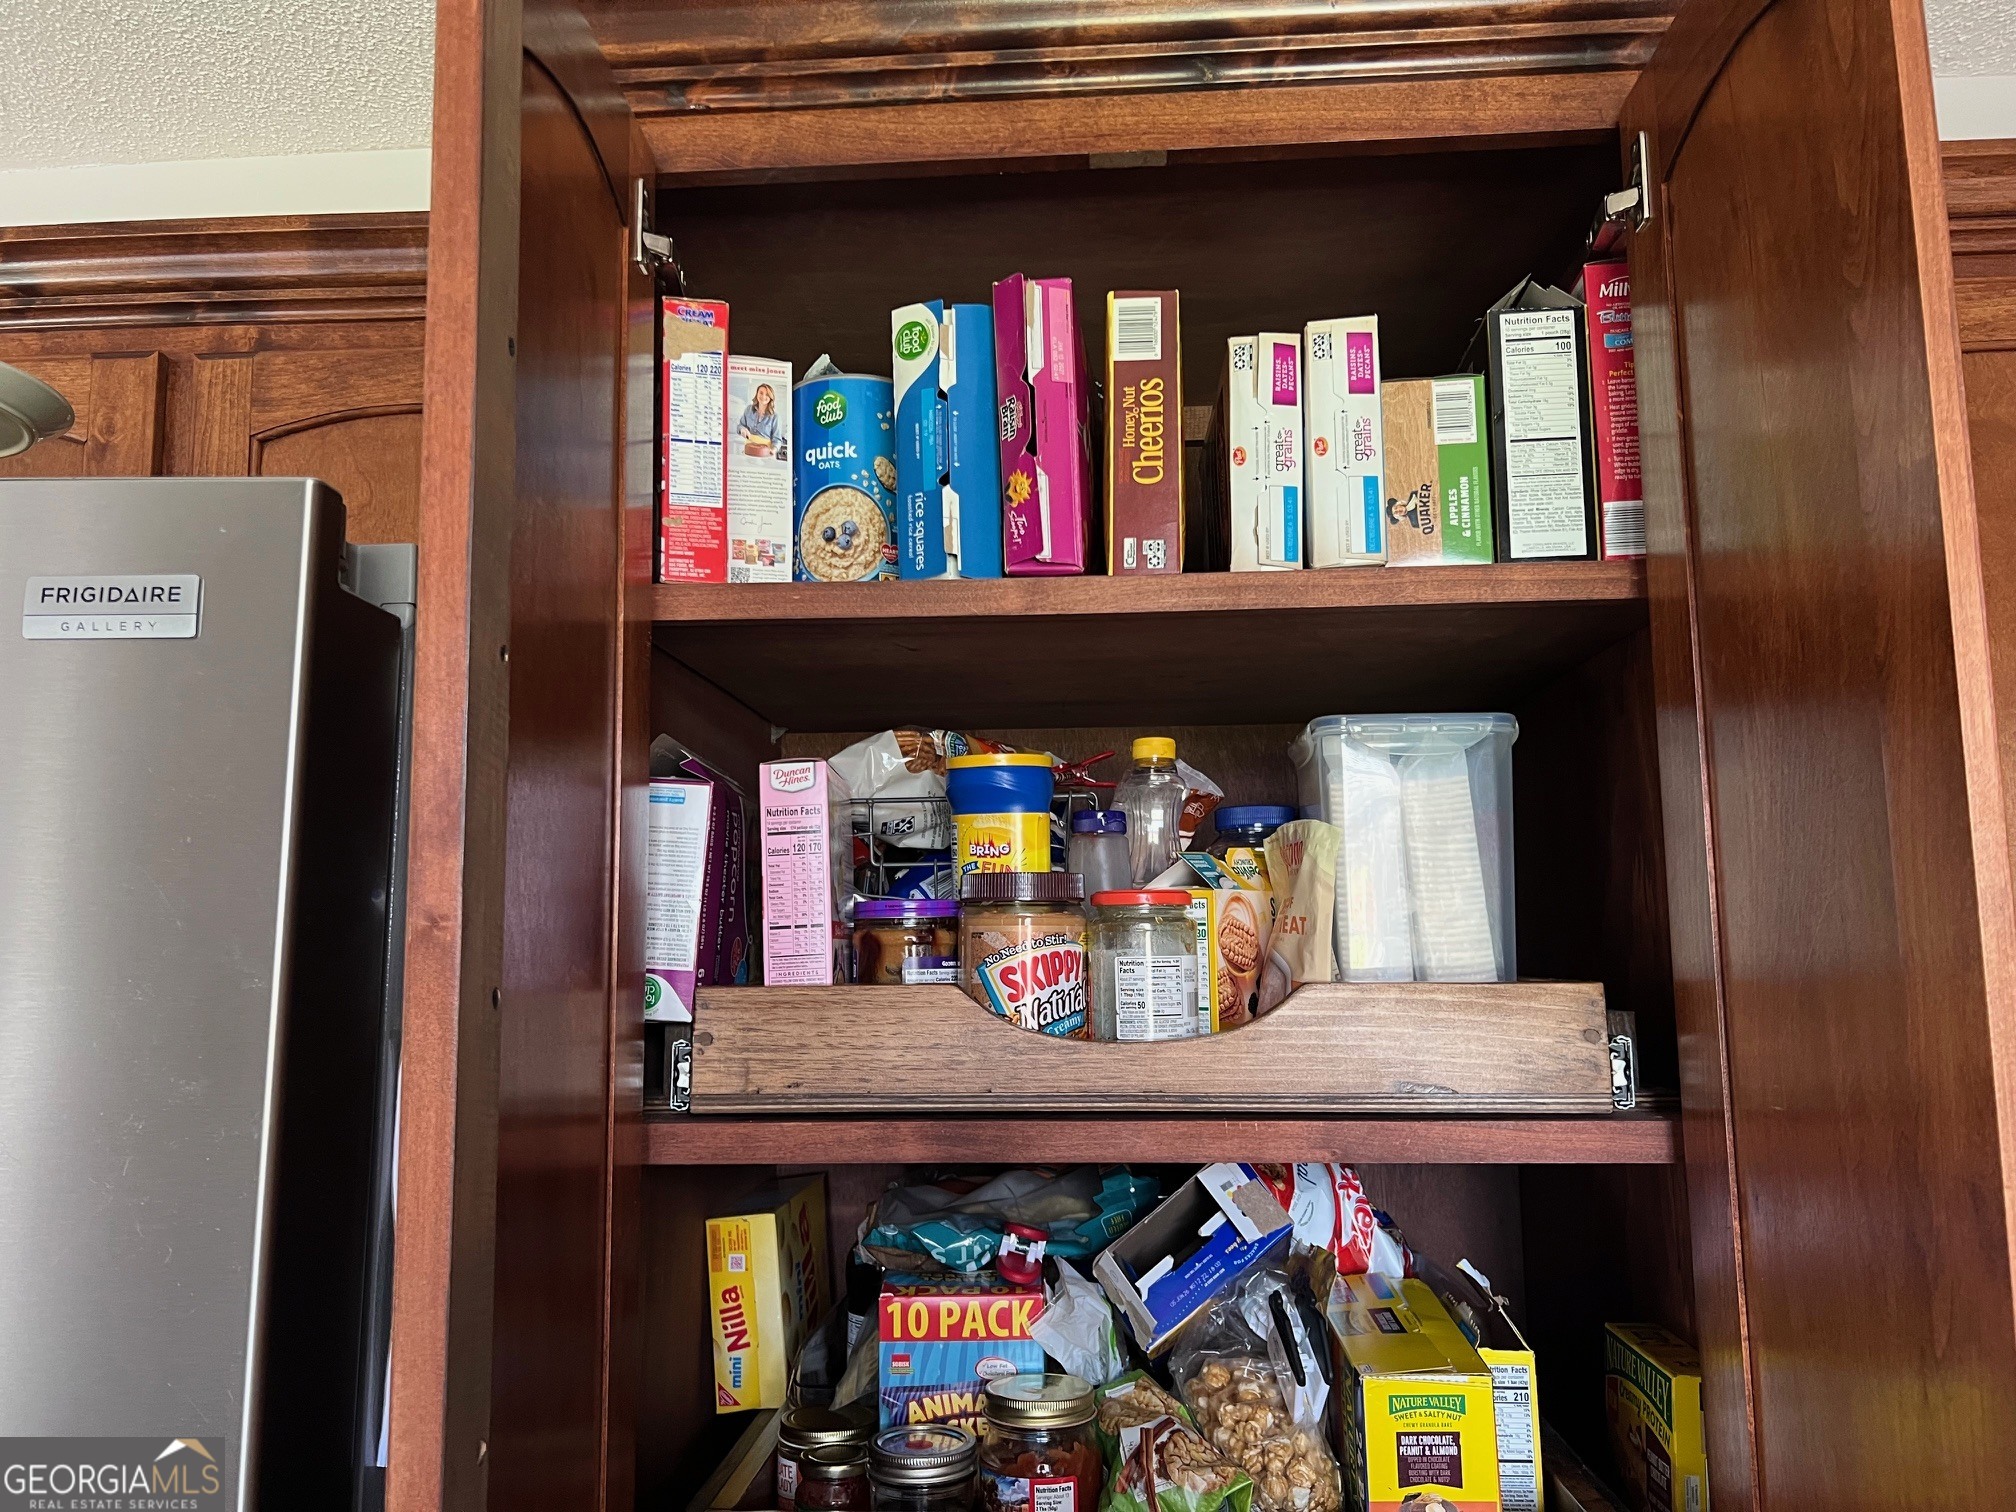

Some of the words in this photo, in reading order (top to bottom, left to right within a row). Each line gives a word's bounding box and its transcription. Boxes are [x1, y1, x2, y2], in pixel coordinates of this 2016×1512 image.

[677, 307, 715, 319] CREAM
[1505, 317, 1543, 326] Nutrition
[1546, 315, 1570, 323] Facts
[900, 329, 911, 354] club
[911, 325, 922, 353] food
[1506, 346, 1534, 354] Calories
[1556, 341, 1572, 351] 100
[671, 363, 692, 372] Calories
[697, 364, 708, 373] 120
[710, 365, 722, 374] 220
[816, 396, 841, 417] food
[1123, 386, 1136, 408] Nut
[820, 408, 843, 425] club
[1000, 405, 1010, 440] Bran
[1007, 395, 1017, 440] Raisin
[1123, 410, 1139, 448] Honey
[1132, 378, 1164, 485] Cheerios
[1362, 418, 1376, 462] grains
[805, 441, 858, 466] quick
[1275, 438, 1288, 472] great
[1283, 429, 1297, 471] grains
[1355, 428, 1368, 462] great
[818, 461, 841, 470] OATS
[915, 491, 926, 518] rice
[1422, 483, 1433, 536] QUAKER
[1449, 488, 1458, 526] APPLES
[1460, 476, 1471, 528] CINNAMON
[1007, 511, 1022, 546] Scoops!
[1016, 514, 1028, 536] Two
[1462, 529, 1471, 538] &
[913, 520, 926, 571] squares
[40, 586, 182, 604] FRIGIDAIRE
[61, 621, 157, 632] GALLERY
[773, 766, 811, 780] Duncan
[778, 775, 810, 788] Hines
[766, 808, 799, 817] Nutrition
[800, 806, 821, 816] Facts
[767, 847, 790, 855] Calories
[793, 843, 806, 852] 120
[808, 842, 822, 852] 170
[969, 844, 1011, 858] BRING
[720, 854, 729, 904] theater
[728, 811, 738, 923] popcorn
[962, 862, 976, 872] THE
[717, 908, 725, 951] butter
[984, 954, 1000, 967] No
[999, 942, 1029, 960] Need
[1031, 937, 1044, 950] to
[1044, 934, 1067, 947] Stir!
[697, 968, 705, 978] 6
[999, 949, 1082, 1003] SKIPPY
[1017, 979, 1087, 1031] Natural
[1137, 1001, 1146, 1010] 50
[1046, 1013, 1082, 1036] Creamy
[896, 1285, 981, 1296] PACK
[990, 1286, 1028, 1295] 10
[719, 1285, 751, 1353] Nilla
[886, 1301, 929, 1339] 10
[939, 1299, 1035, 1338] PACK
[729, 1357, 742, 1389] mini
[1511, 1366, 1528, 1374] Facts
[1606, 1334, 1637, 1381] NATURE
[1636, 1356, 1670, 1422] VALLEY
[908, 1392, 988, 1425] ANIMA
[1392, 1396, 1429, 1412] NATURE
[1428, 1396, 1462, 1412] VALLEY
[1513, 1392, 1530, 1402] 210
[1394, 1410, 1418, 1422] SWEET
[1423, 1410, 1446, 1419] SALTY
[1446, 1413, 1463, 1422] NUT
[1641, 1399, 1671, 1450] PROTEIN
[1399, 1446, 1424, 1456] PEANUT
[1424, 1446, 1431, 1456] &
[1432, 1446, 1459, 1456] ALMOND
[1401, 1435, 1418, 1446] DARK
[1419, 1435, 1456, 1446] CHOCOLATE,
